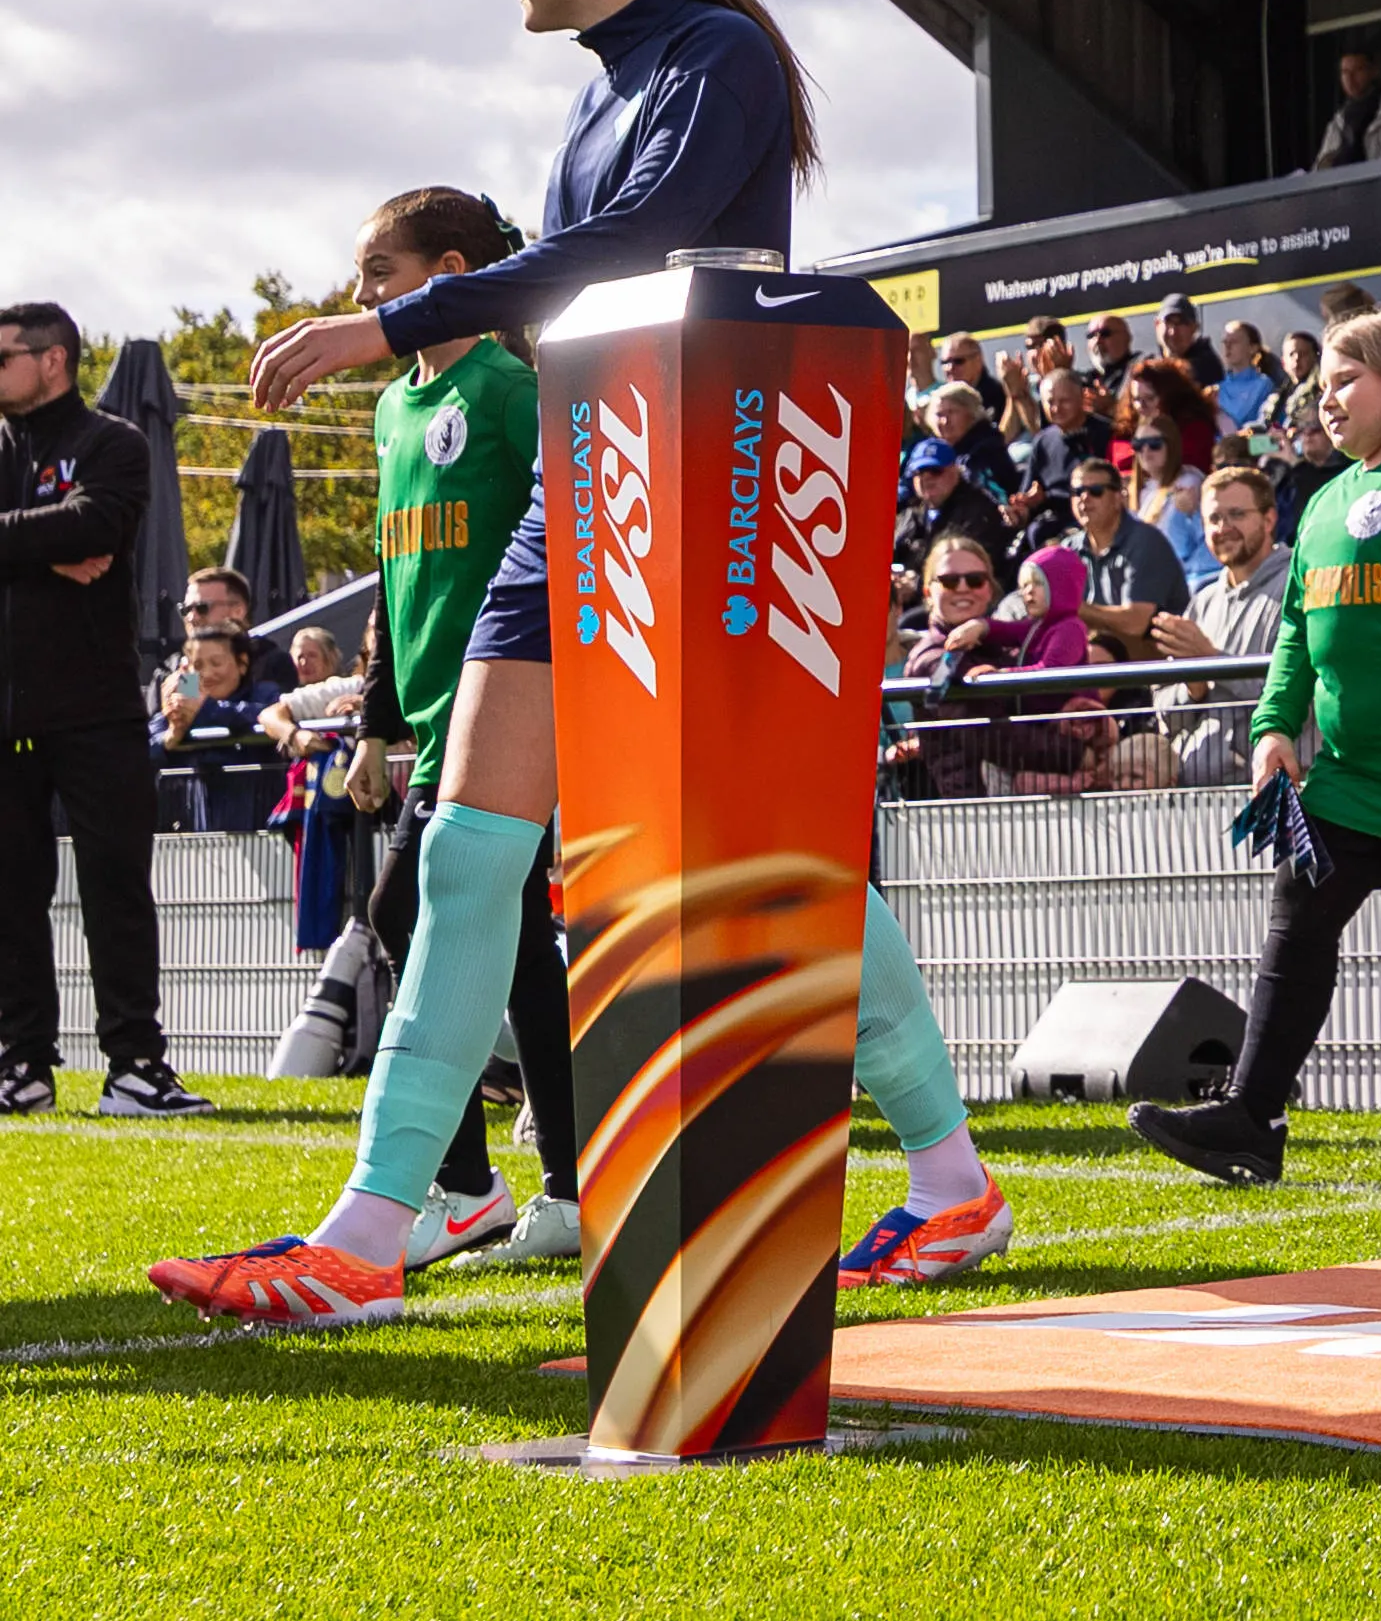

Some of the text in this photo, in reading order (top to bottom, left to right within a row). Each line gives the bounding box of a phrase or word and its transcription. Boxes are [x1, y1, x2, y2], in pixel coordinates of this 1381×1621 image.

[984, 224, 1350, 303] Whatever your property goals, we're here to assist you
[572, 402, 596, 594] BARCLAYS
[599, 382, 657, 699] WSL
[727, 389, 764, 585] BARCLAYS
[768, 382, 851, 698] WSL
